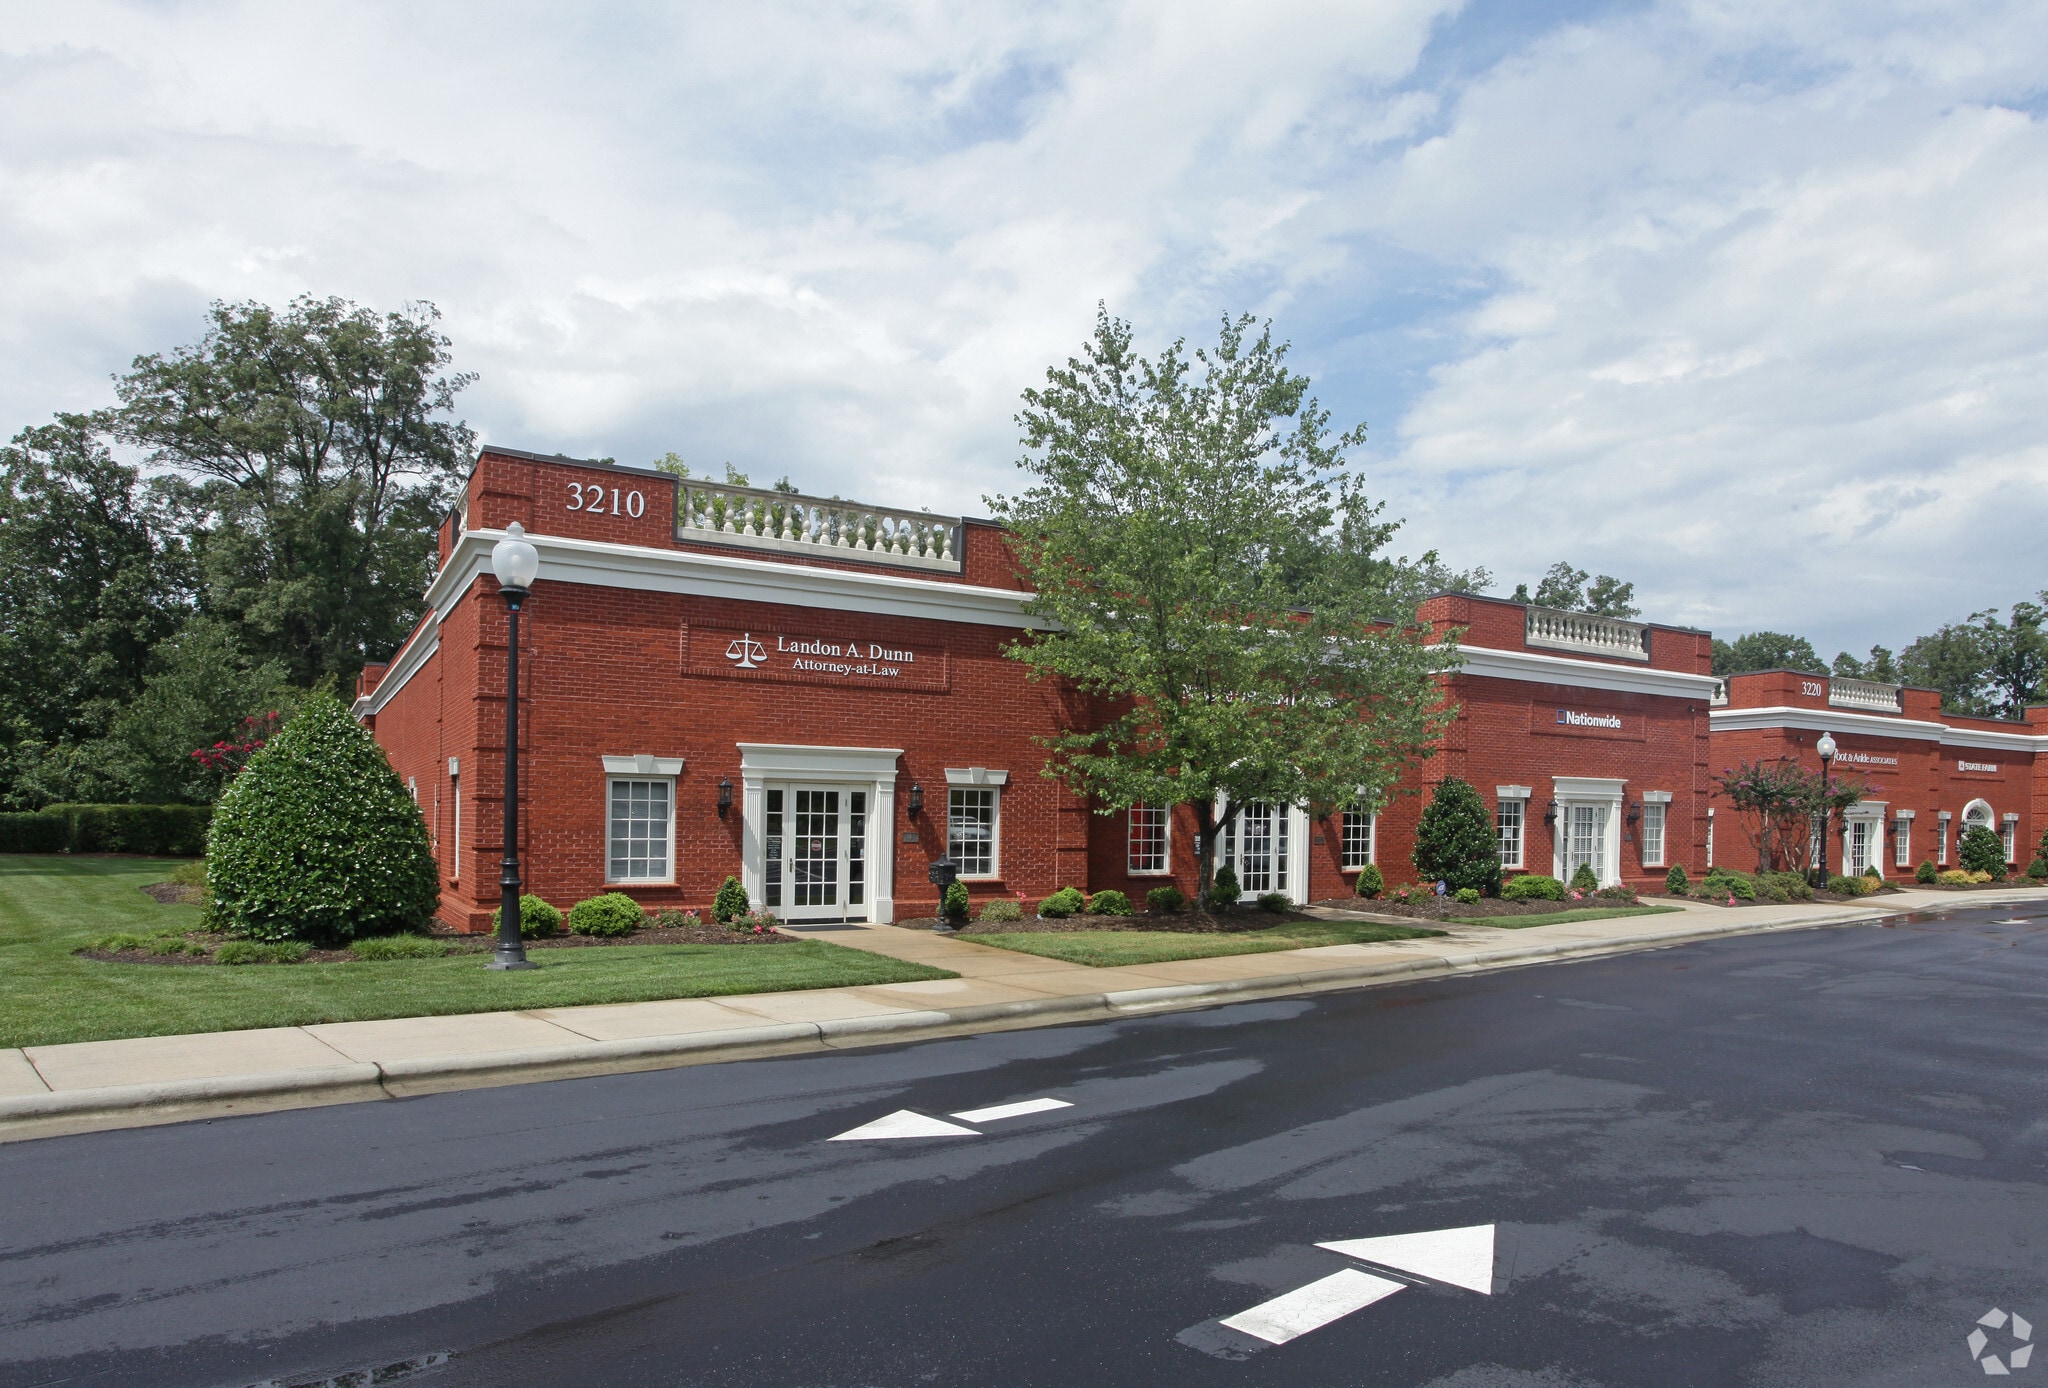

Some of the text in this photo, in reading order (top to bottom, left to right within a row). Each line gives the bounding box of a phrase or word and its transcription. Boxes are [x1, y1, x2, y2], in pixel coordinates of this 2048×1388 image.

[566, 482, 644, 518] 3210
[777, 636, 913, 662] Landon A. Dunn
[793, 658, 899, 676] Attorney-at-Law
[1801, 681, 1822, 697] 3220
[1566, 711, 1621, 728] Nationwide
